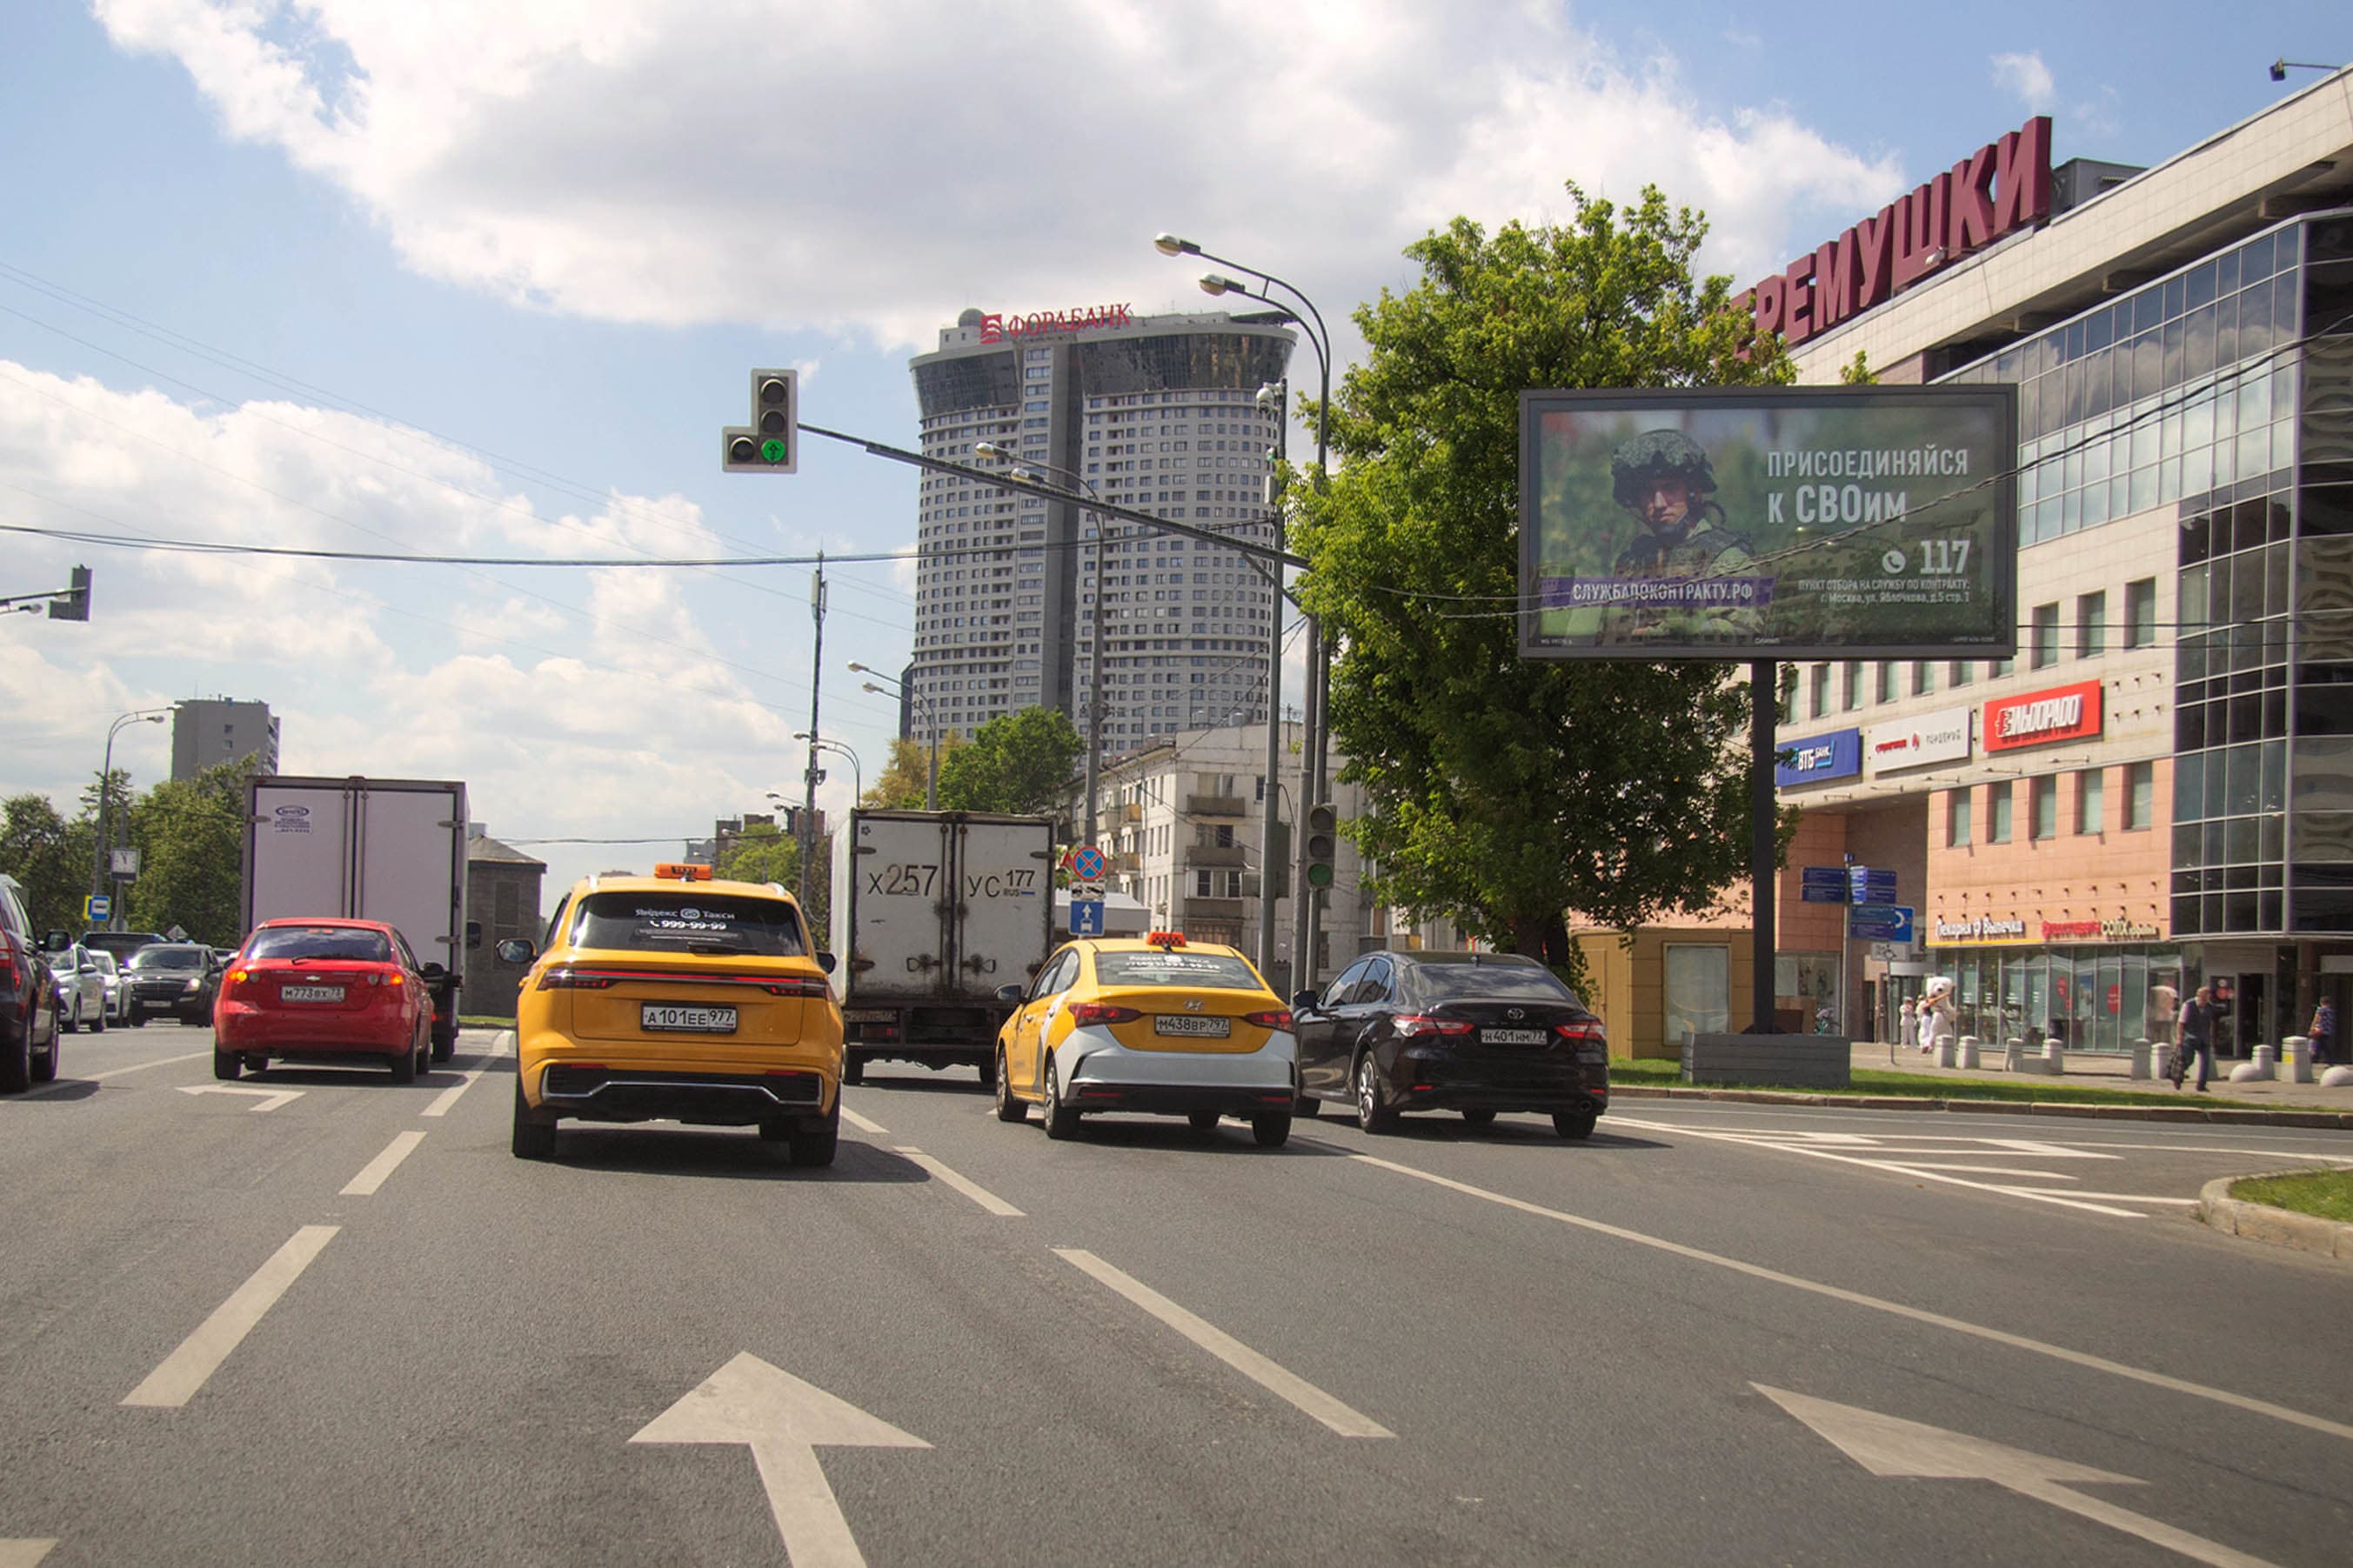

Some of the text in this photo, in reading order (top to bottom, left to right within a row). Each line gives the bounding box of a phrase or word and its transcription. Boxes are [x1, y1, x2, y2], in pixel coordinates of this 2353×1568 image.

[1710, 117, 2052, 372] РЕМУШКИ
[1008, 302, 1131, 338] ФОРАБАНК
[1767, 444, 1969, 479] ПРИСОЕДИНЯЙСЯ
[1920, 539, 1970, 575] 117
[1827, 579, 1858, 591] ОТБОРА
[1006, 870, 1035, 887] 177
[1003, 888, 1020, 897] RUS
[703, 911, 735, 919] Такси
[661, 920, 727, 931] 999-99-99
[709, 1008, 732, 1022] 977
